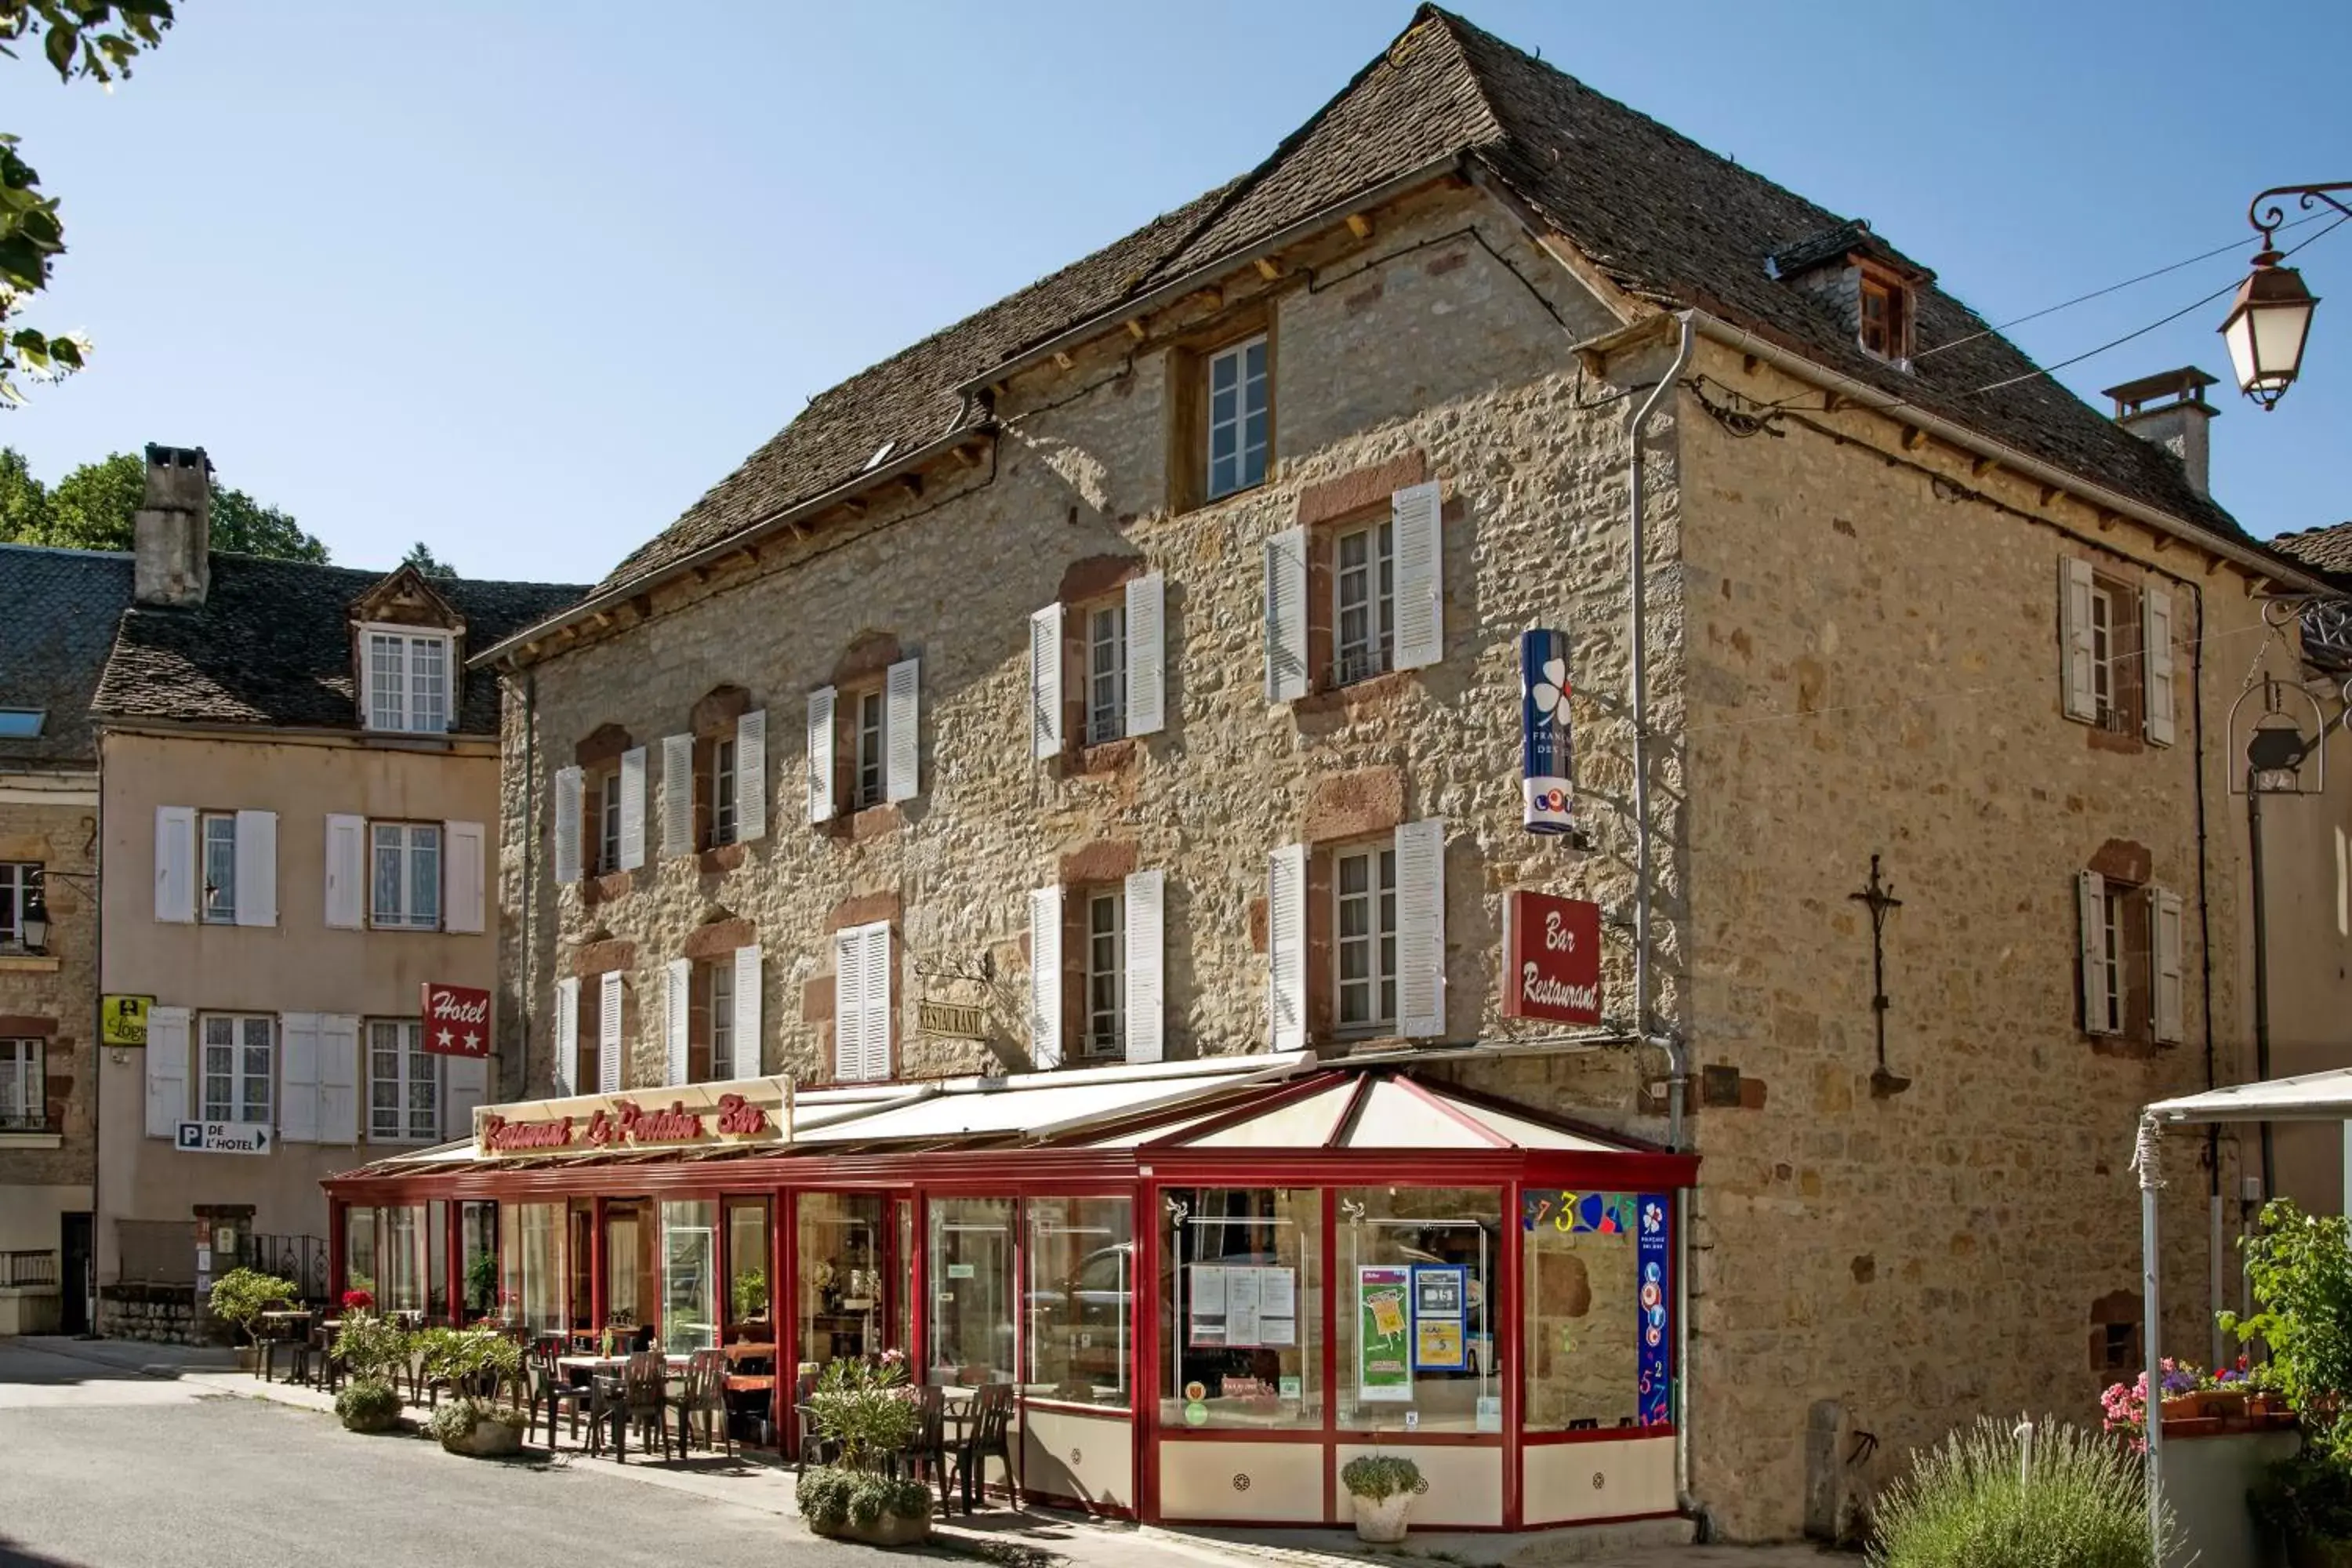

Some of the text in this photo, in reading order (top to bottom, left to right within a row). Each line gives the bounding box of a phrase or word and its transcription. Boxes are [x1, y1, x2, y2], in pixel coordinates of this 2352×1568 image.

[1545, 910, 1575, 953] Bar
[1523, 961, 1597, 1011] Restaurant
[432, 990, 487, 1023] Hotel
[717, 1093, 766, 1134] Bar
[183, 1125, 224, 1144] P DE
[206, 1138, 254, 1150] L'HOTEL
